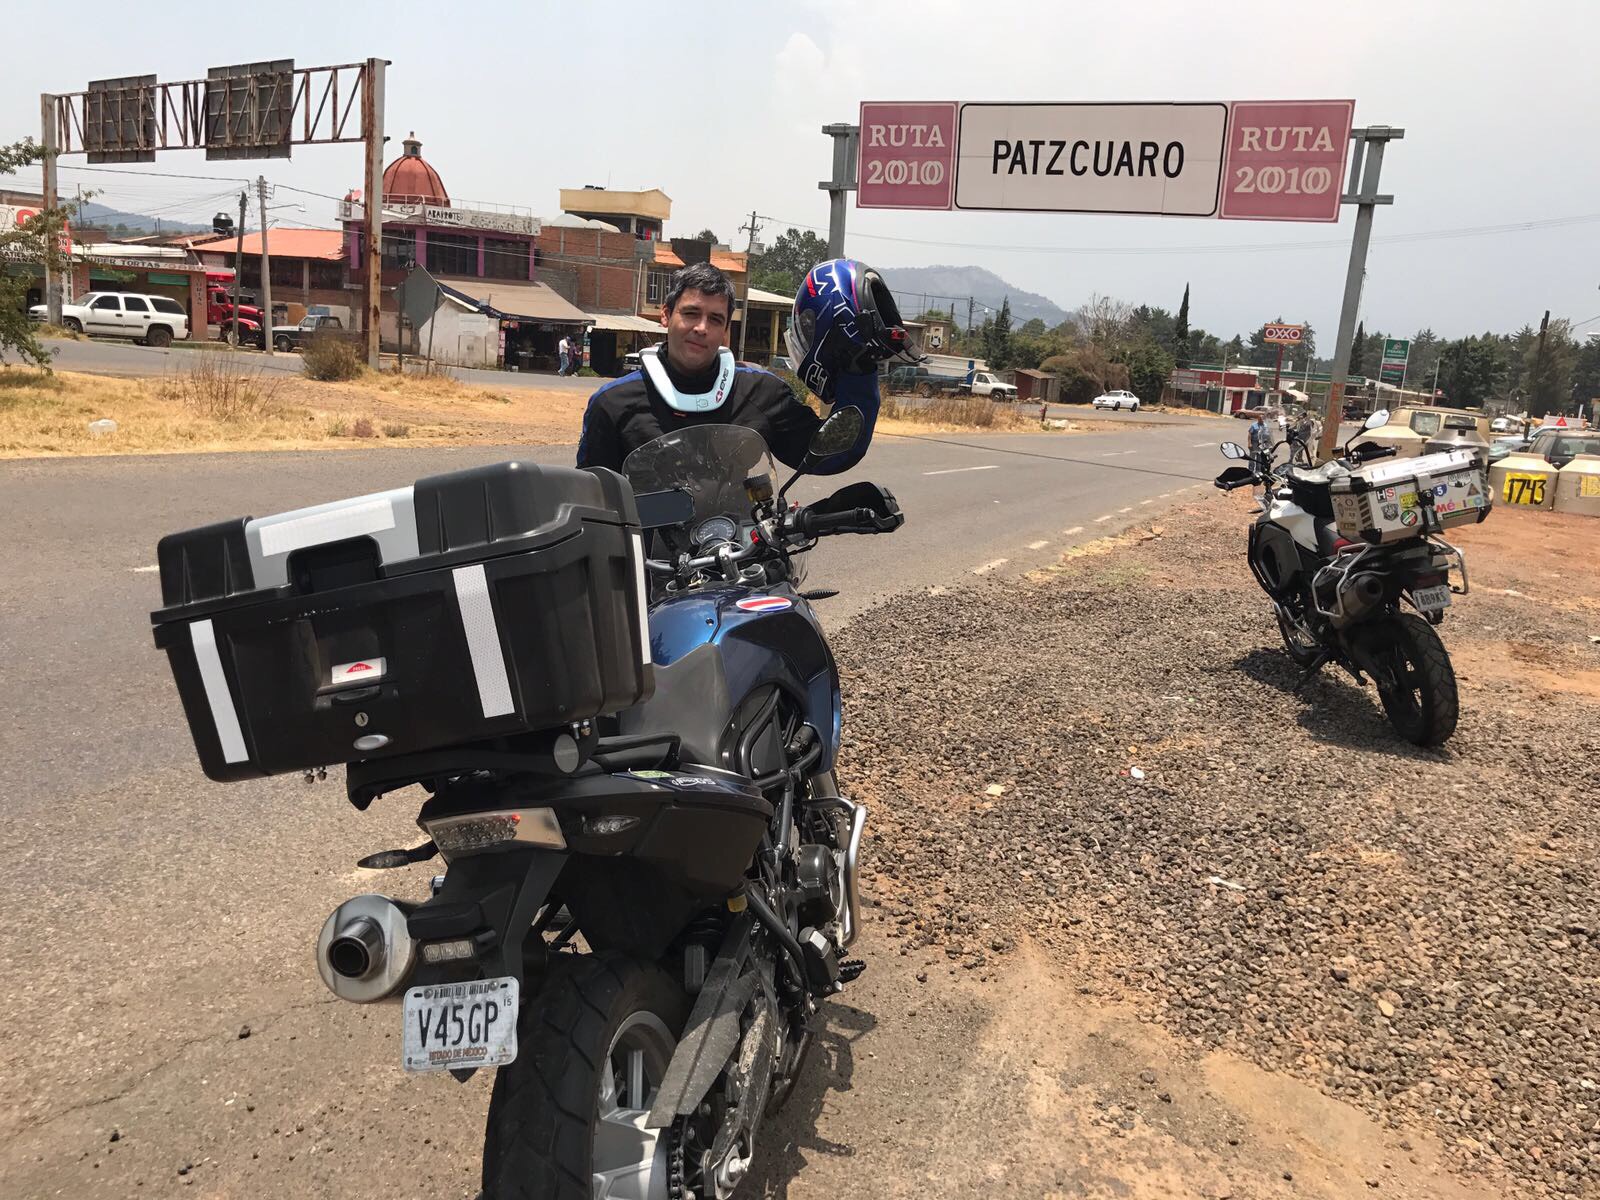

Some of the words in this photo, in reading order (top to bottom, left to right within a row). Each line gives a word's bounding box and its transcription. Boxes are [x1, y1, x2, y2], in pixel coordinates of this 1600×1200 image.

[868, 124, 946, 148] RUTA
[1238, 126, 1335, 152] RUTA
[992, 139, 1185, 178] PATZCUARO
[866, 159, 945, 186] 2010
[1233, 166, 1332, 195] 2010
[88, 255, 116, 265] UPER
[121, 259, 160, 268] TORTAS
[1265, 327, 1301, 340] OXXO
[1507, 478, 1547, 505] 1743
[503, 998, 512, 1007] 15
[418, 1000, 500, 1049] V45GP
